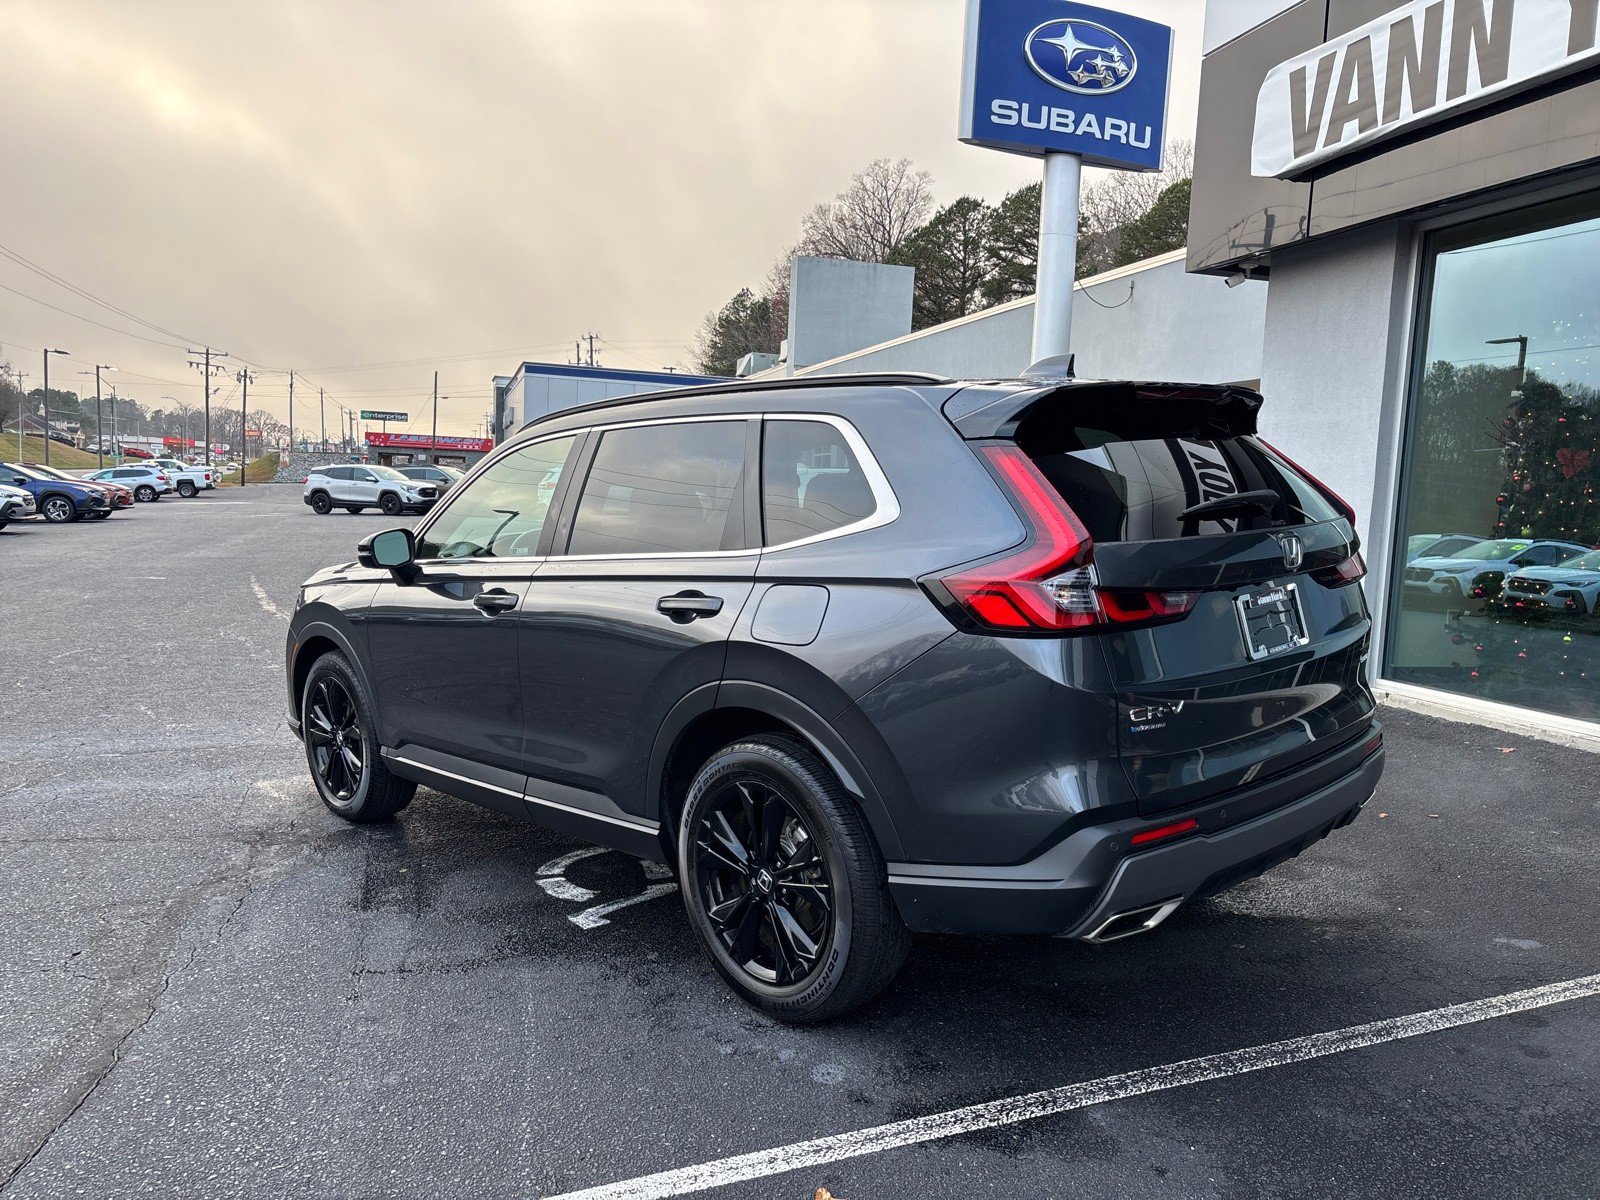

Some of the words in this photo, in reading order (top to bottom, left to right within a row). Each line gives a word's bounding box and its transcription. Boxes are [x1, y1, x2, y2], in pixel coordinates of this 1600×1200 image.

[1289, 0, 1515, 159] VANN
[990, 98, 1152, 149] SUBARU
[363, 412, 408, 420] enterprise
[1129, 700, 1185, 722] CR-V
